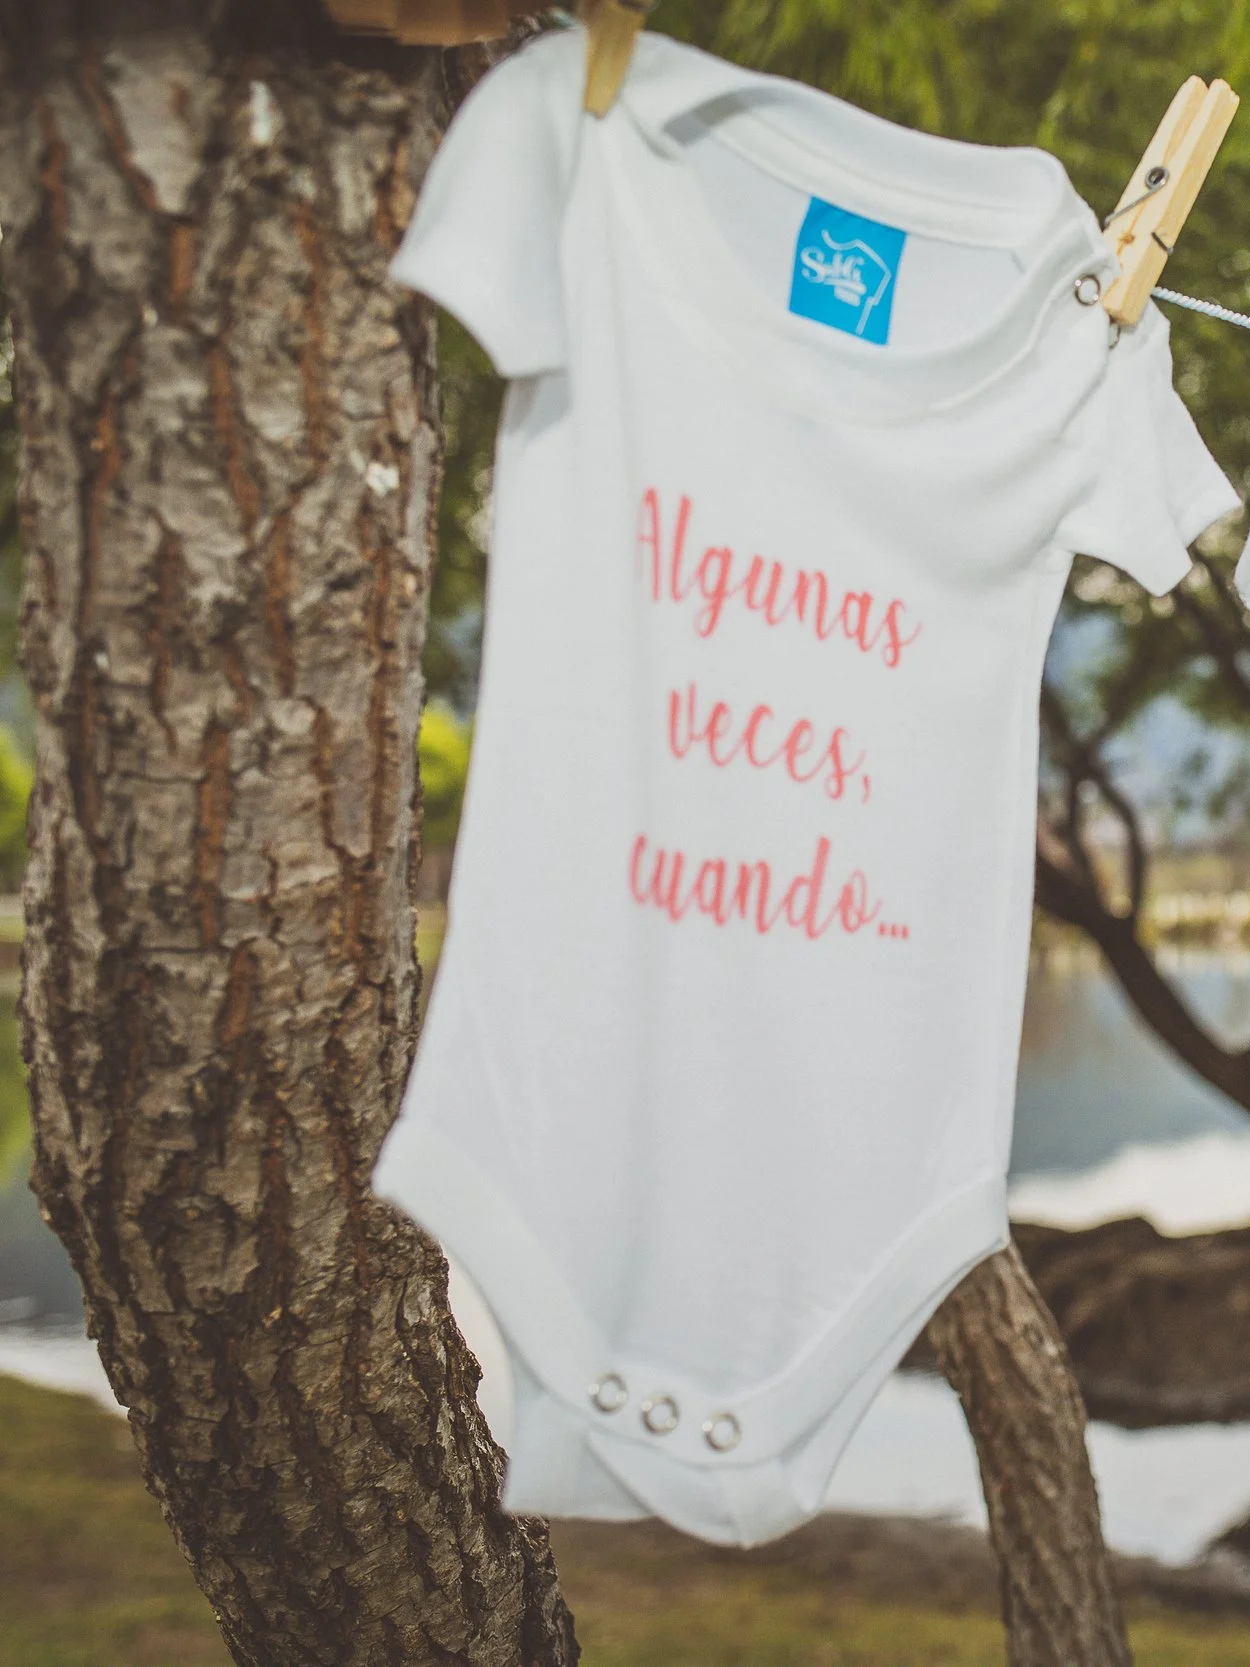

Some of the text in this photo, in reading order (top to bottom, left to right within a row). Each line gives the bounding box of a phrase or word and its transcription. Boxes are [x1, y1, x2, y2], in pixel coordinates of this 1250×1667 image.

[637, 486, 922, 668] Algunas
[668, 682, 872, 803] veces,
[629, 834, 911, 941] cuando...
